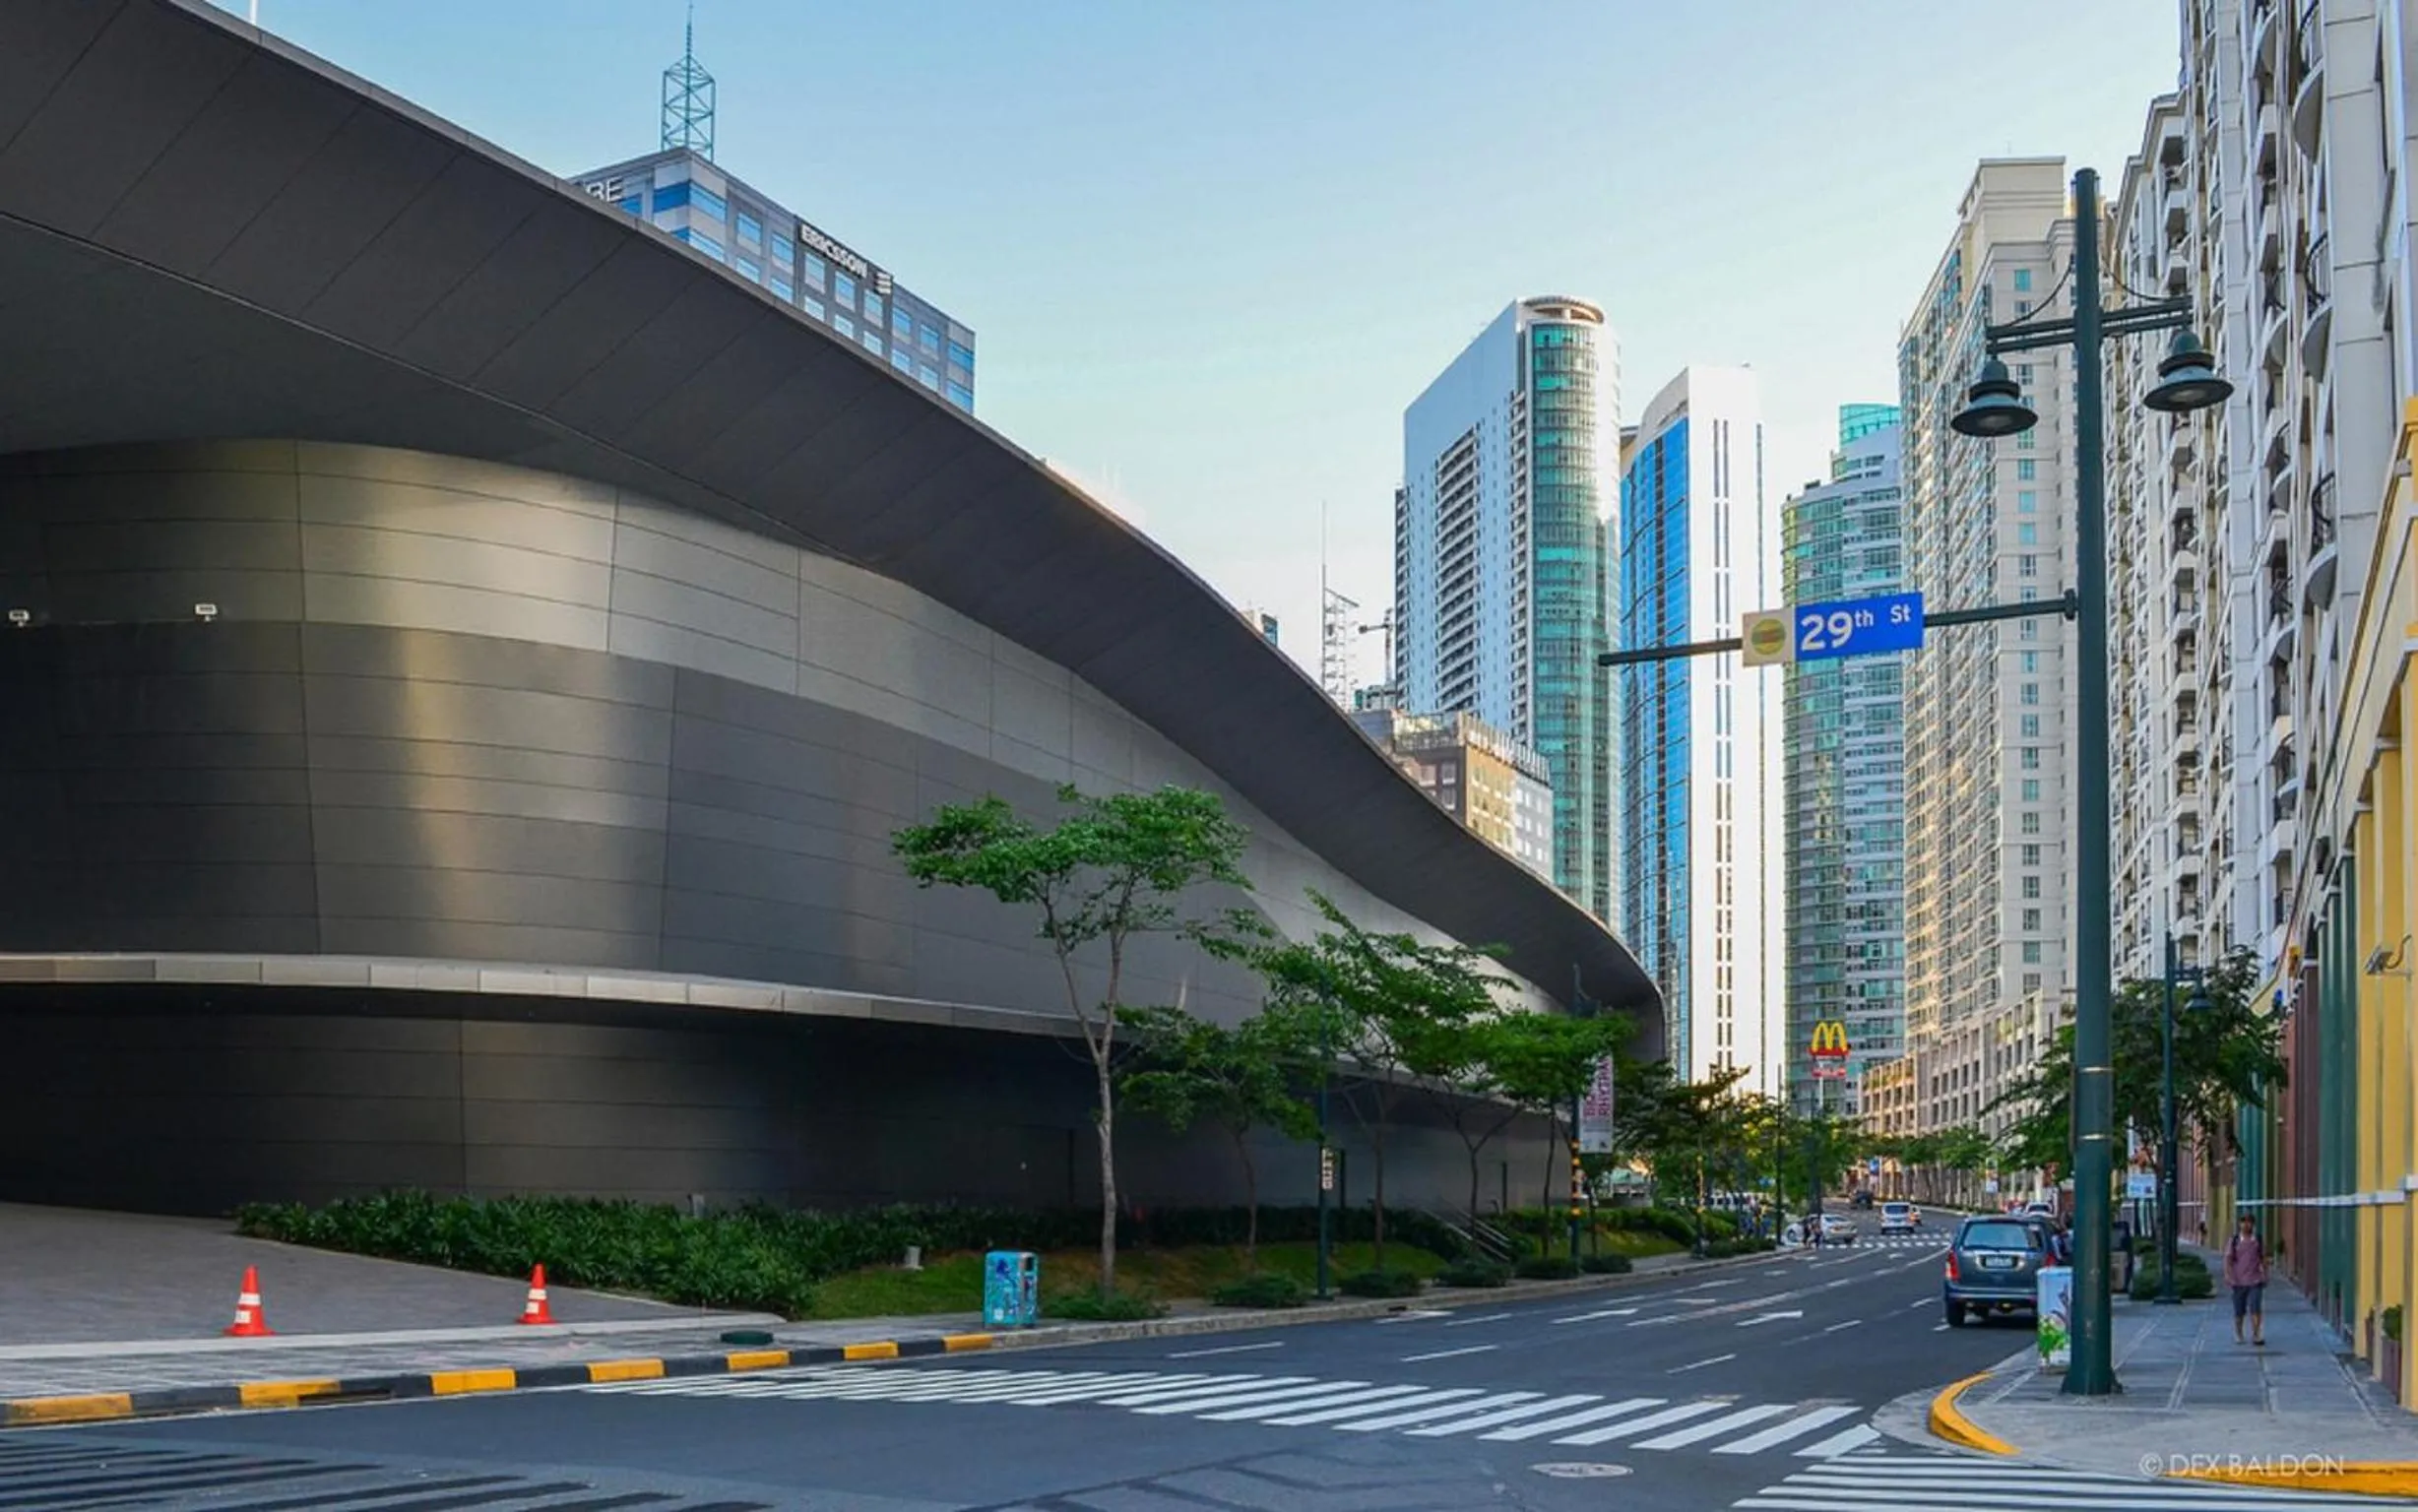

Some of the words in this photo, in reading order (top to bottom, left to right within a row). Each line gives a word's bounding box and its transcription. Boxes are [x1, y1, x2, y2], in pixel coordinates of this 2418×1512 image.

[801, 223, 867, 279] ERICSSON
[1801, 609, 1874, 652] 29th
[1890, 603, 1911, 625] St
